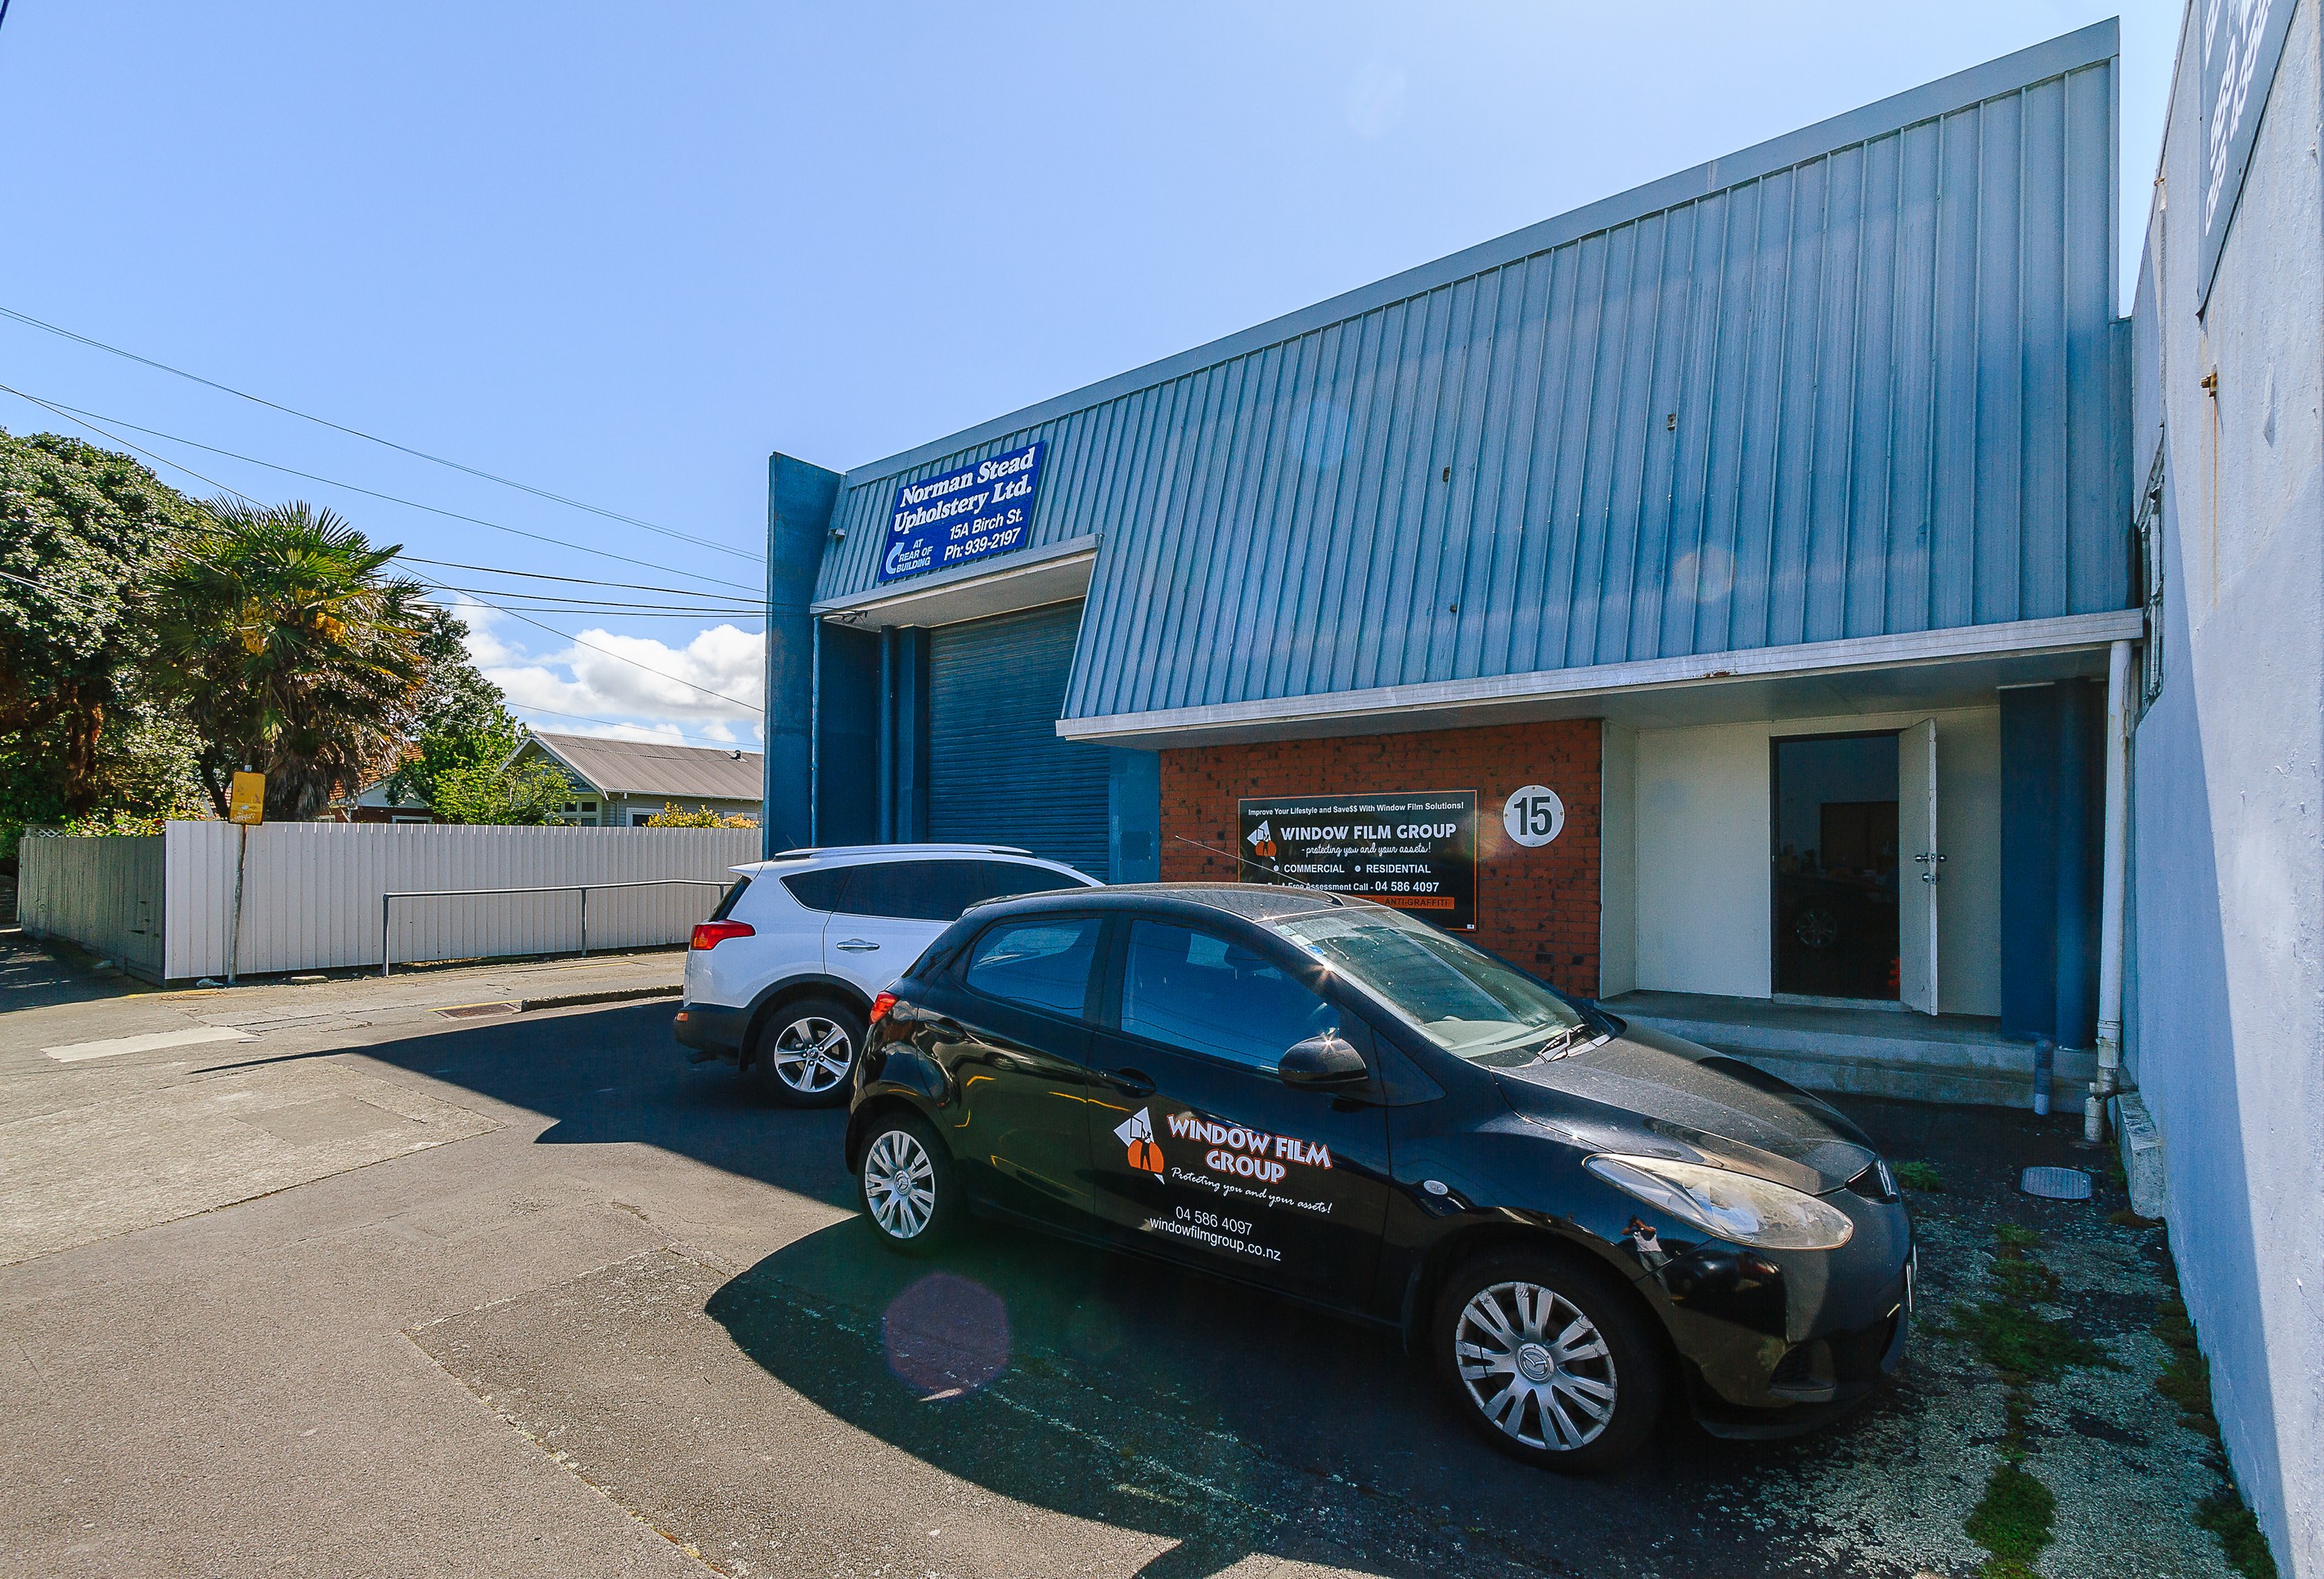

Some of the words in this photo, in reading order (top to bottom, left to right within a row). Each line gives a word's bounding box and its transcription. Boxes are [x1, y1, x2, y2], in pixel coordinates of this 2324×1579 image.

[2210, 34, 2235, 170] 569
[900, 471, 973, 507] Norman
[977, 447, 1036, 484] Stead
[893, 491, 989, 535] Upholstery
[991, 474, 1032, 503] Ltd.
[950, 523, 969, 540] 15A
[972, 512, 1004, 534] Birch
[1006, 508, 1023, 524] St.
[898, 547, 920, 562] REAR
[921, 546, 933, 556] OF
[913, 538, 924, 549] AT
[964, 527, 1021, 556] 939-2197
[896, 557, 931, 574] BUILDING
[1248, 808, 1273, 816] Improve
[1290, 806, 1318, 815] Lifestyle
[1333, 805, 1358, 813] Save$$
[1359, 804, 1375, 812] With
[1376, 803, 1406, 812] Window
[1407, 803, 1423, 811] Film
[1425, 802, 1464, 810] Solutions!
[1514, 796, 1553, 835] 15
[1280, 825, 1349, 840] WINDOW
[1354, 825, 1391, 839] FILM
[1396, 823, 1456, 839] GROUP
[1306, 843, 1342, 857] protecting
[1343, 846, 1359, 857] you
[1360, 842, 1377, 853] and
[1378, 846, 1398, 857] your
[1399, 842, 1432, 853] assets!
[1283, 864, 1345, 873] COMMERCIAL
[1366, 864, 1432, 873] RESIDENTIAL
[1353, 883, 1369, 891] Call
[1375, 881, 1388, 892] 04
[1391, 881, 1410, 892] 586
[1412, 882, 1440, 893] 4097
[1384, 898, 1448, 906] ANTI-GRAFFITI
[1166, 1114, 1270, 1155] WINDOW
[1274, 1135, 1333, 1169] FILM
[1205, 1149, 1287, 1184] GROUP
[1171, 1167, 1220, 1192] Protecting
[1223, 1183, 1243, 1196] you
[1245, 1188, 1267, 1199] and
[1268, 1194, 1295, 1207] your
[1297, 1202, 1333, 1214] assets!
[1175, 1206, 1191, 1221] 04
[1194, 1210, 1218, 1227] 586
[1221, 1217, 1252, 1235] 4097
[1149, 1217, 1281, 1262] windowfilmgroup.co.nz
